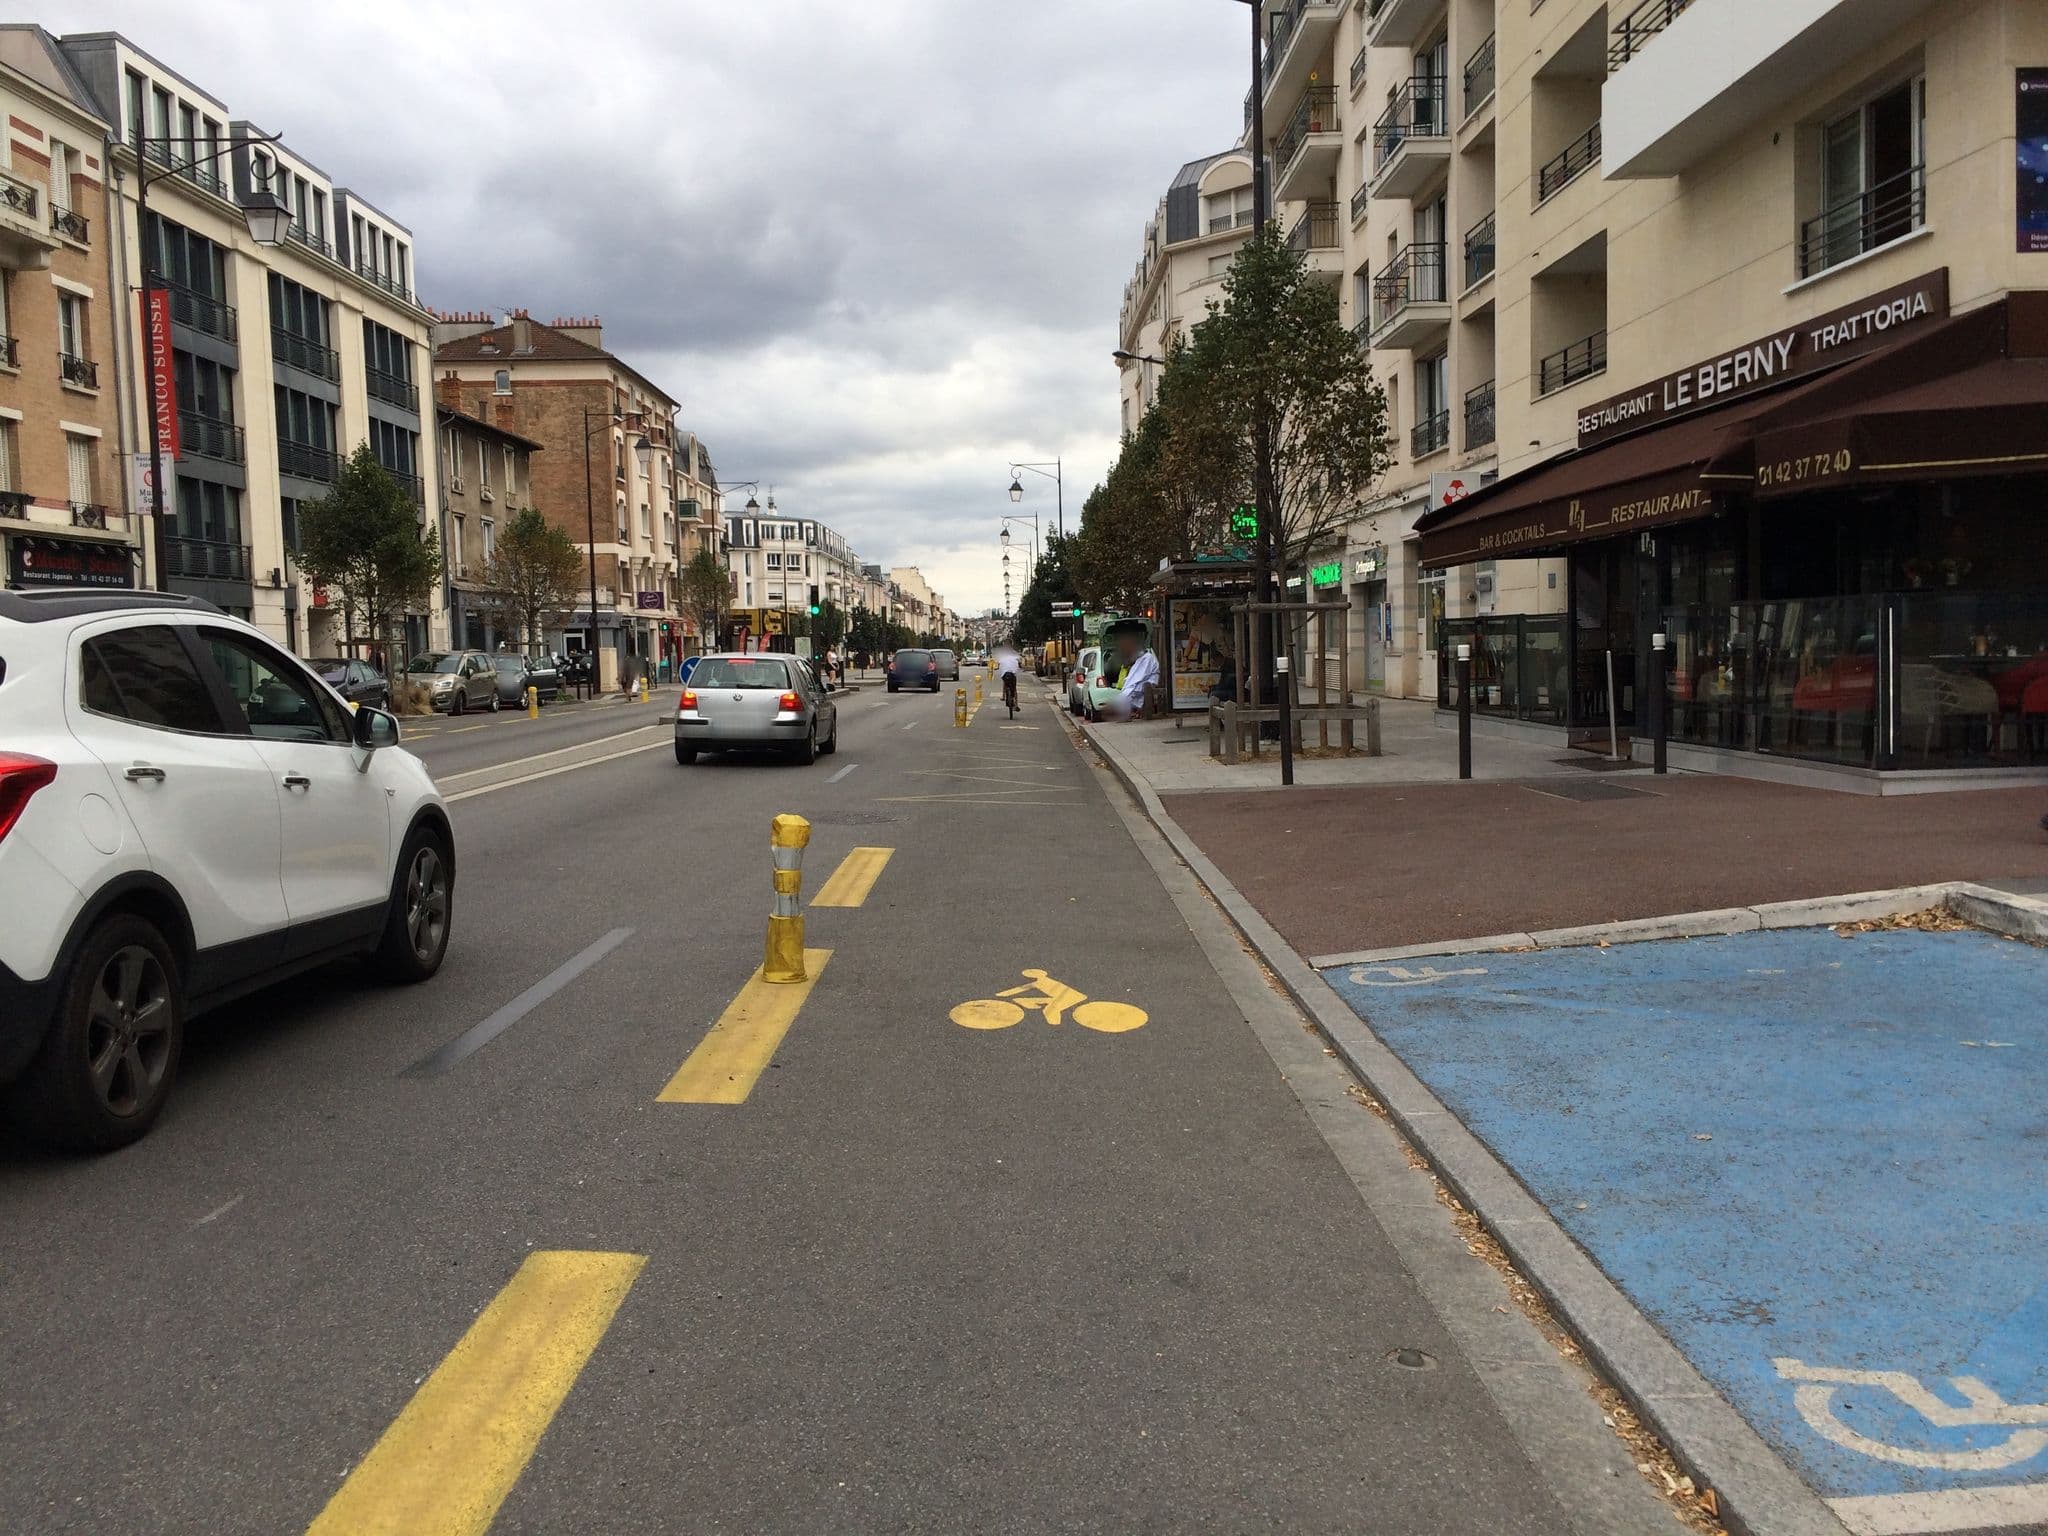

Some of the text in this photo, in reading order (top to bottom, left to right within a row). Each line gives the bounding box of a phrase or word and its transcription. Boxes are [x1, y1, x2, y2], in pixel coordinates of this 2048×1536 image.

[150, 298, 172, 454] FRANCO SUISSE
[1577, 291, 1927, 434] RESTAURANT LE BERNY TRATTORIA
[1759, 448, 1851, 486] 01 42 37 72 40
[1479, 490, 1702, 550] BAR & COCKTAILS RESTAURANT
